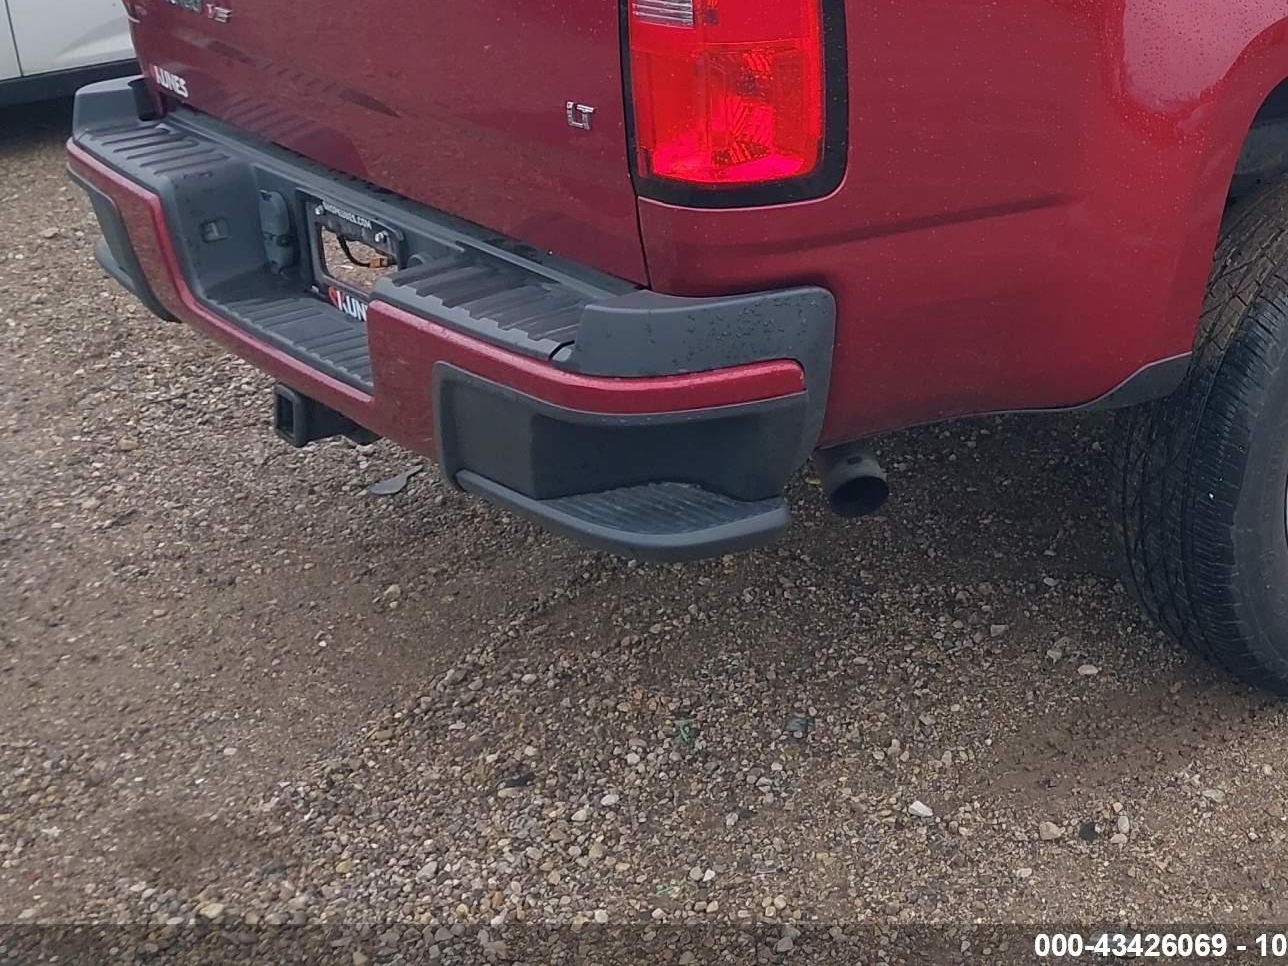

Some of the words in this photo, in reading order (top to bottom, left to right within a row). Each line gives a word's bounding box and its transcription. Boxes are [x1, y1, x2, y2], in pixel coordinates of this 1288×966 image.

[151, 65, 189, 98] KUNES
[566, 101, 596, 131] LT
[334, 289, 368, 322] KUN
